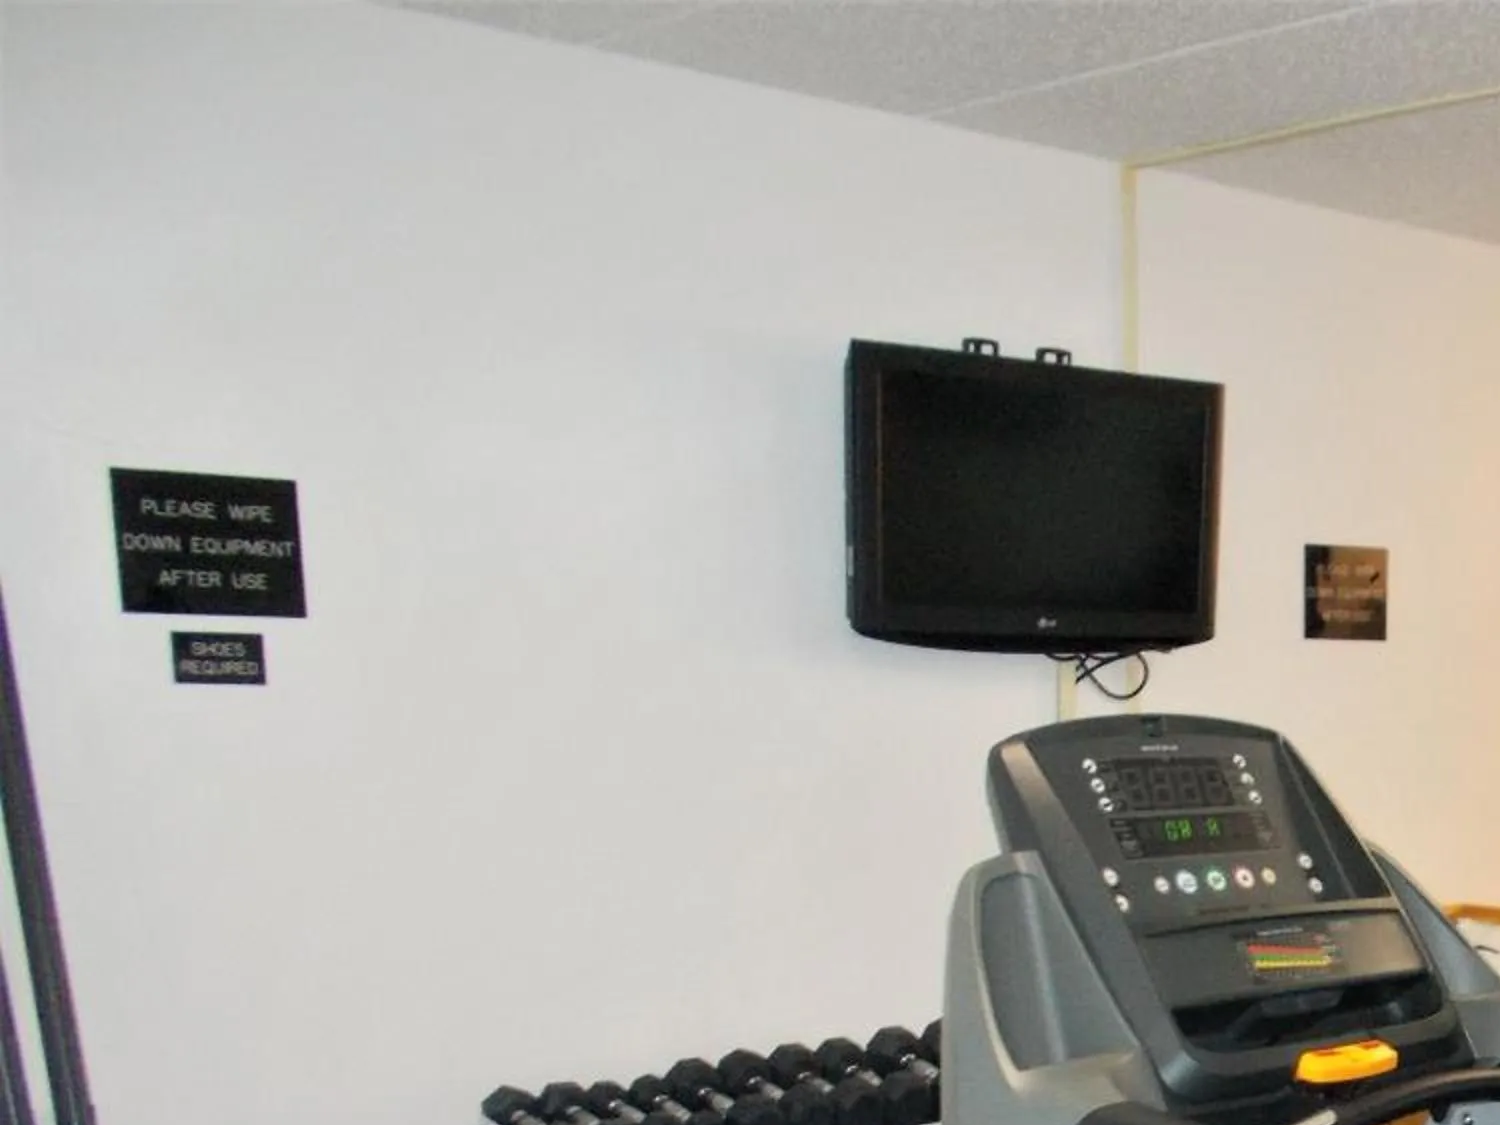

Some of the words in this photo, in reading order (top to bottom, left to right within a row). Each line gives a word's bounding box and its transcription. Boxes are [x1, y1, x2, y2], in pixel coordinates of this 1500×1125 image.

[140, 499, 216, 520] PLEASE
[228, 504, 273, 523] WIPE
[123, 532, 182, 553] DOWN
[190, 536, 294, 558] EQUIPMENT
[158, 568, 221, 588] AFTER
[231, 573, 269, 590] USE
[192, 641, 245, 657] SHOES
[180, 659, 259, 676] REQUIRED
